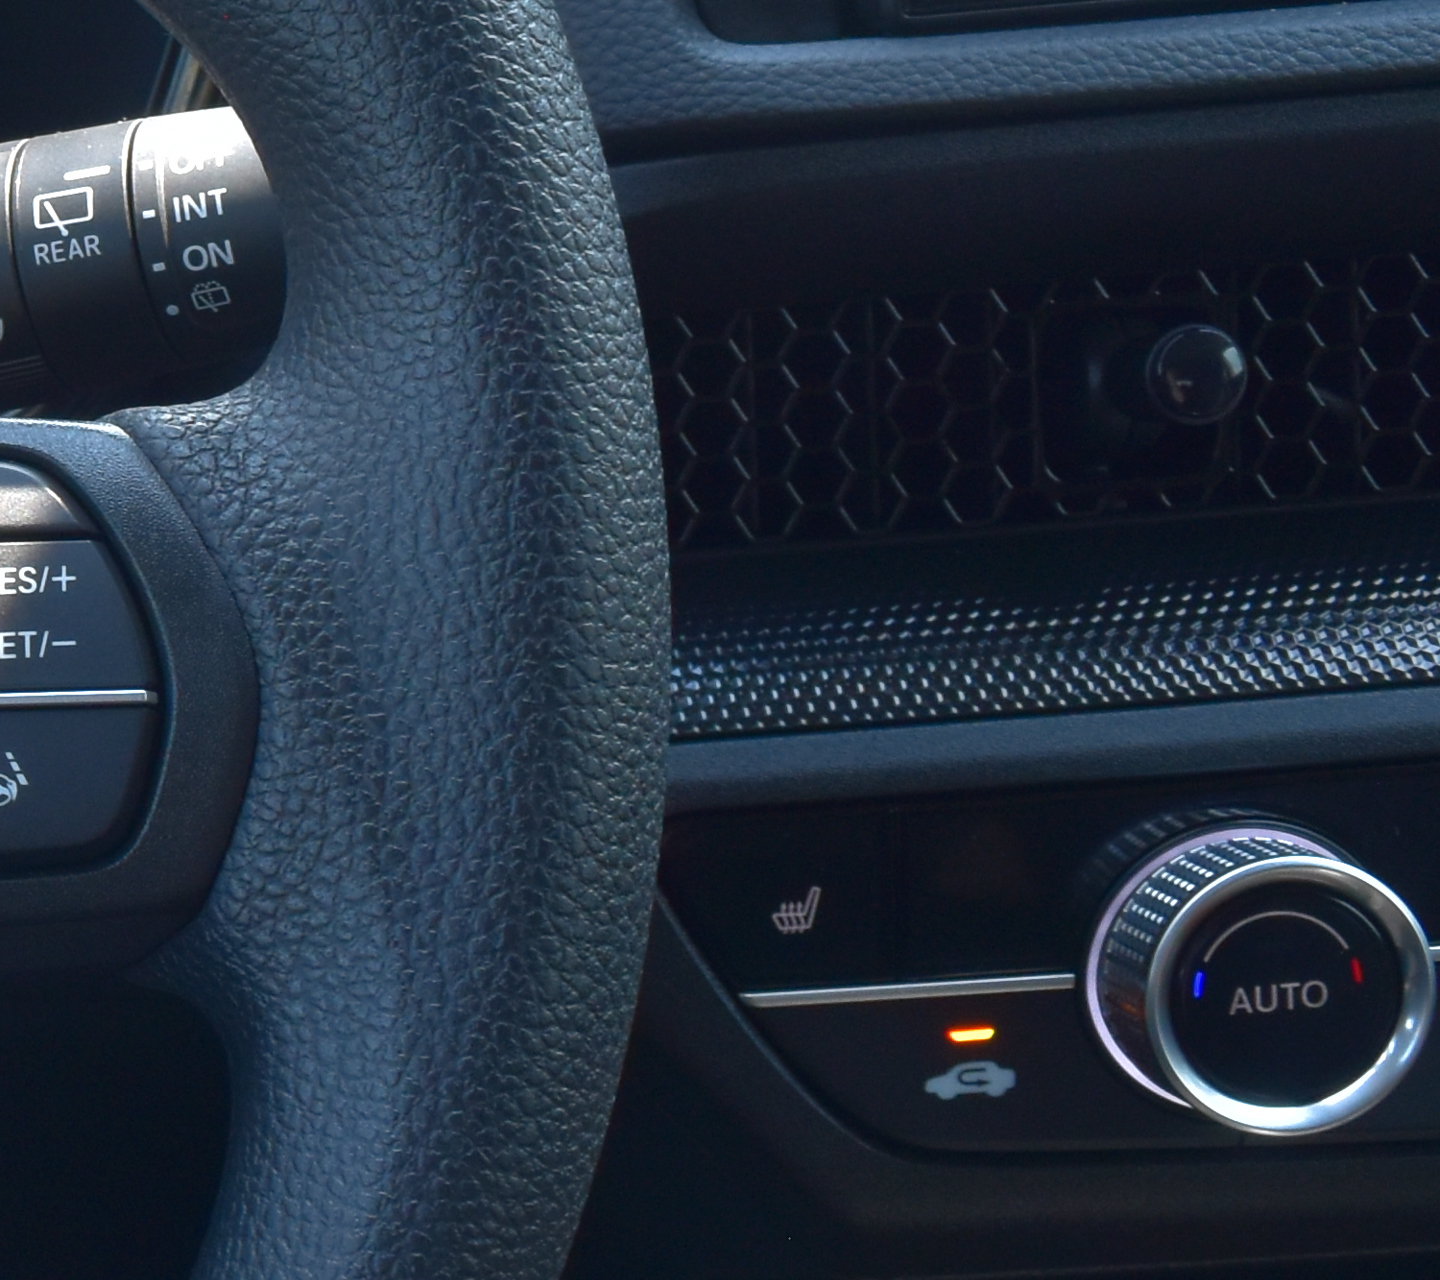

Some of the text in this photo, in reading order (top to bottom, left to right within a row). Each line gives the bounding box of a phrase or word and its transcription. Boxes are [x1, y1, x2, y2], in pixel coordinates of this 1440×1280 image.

[173, 187, 228, 224] INT
[34, 234, 101, 266] REAR
[182, 240, 234, 272] ON
[1229, 979, 1328, 1017] AUTO
